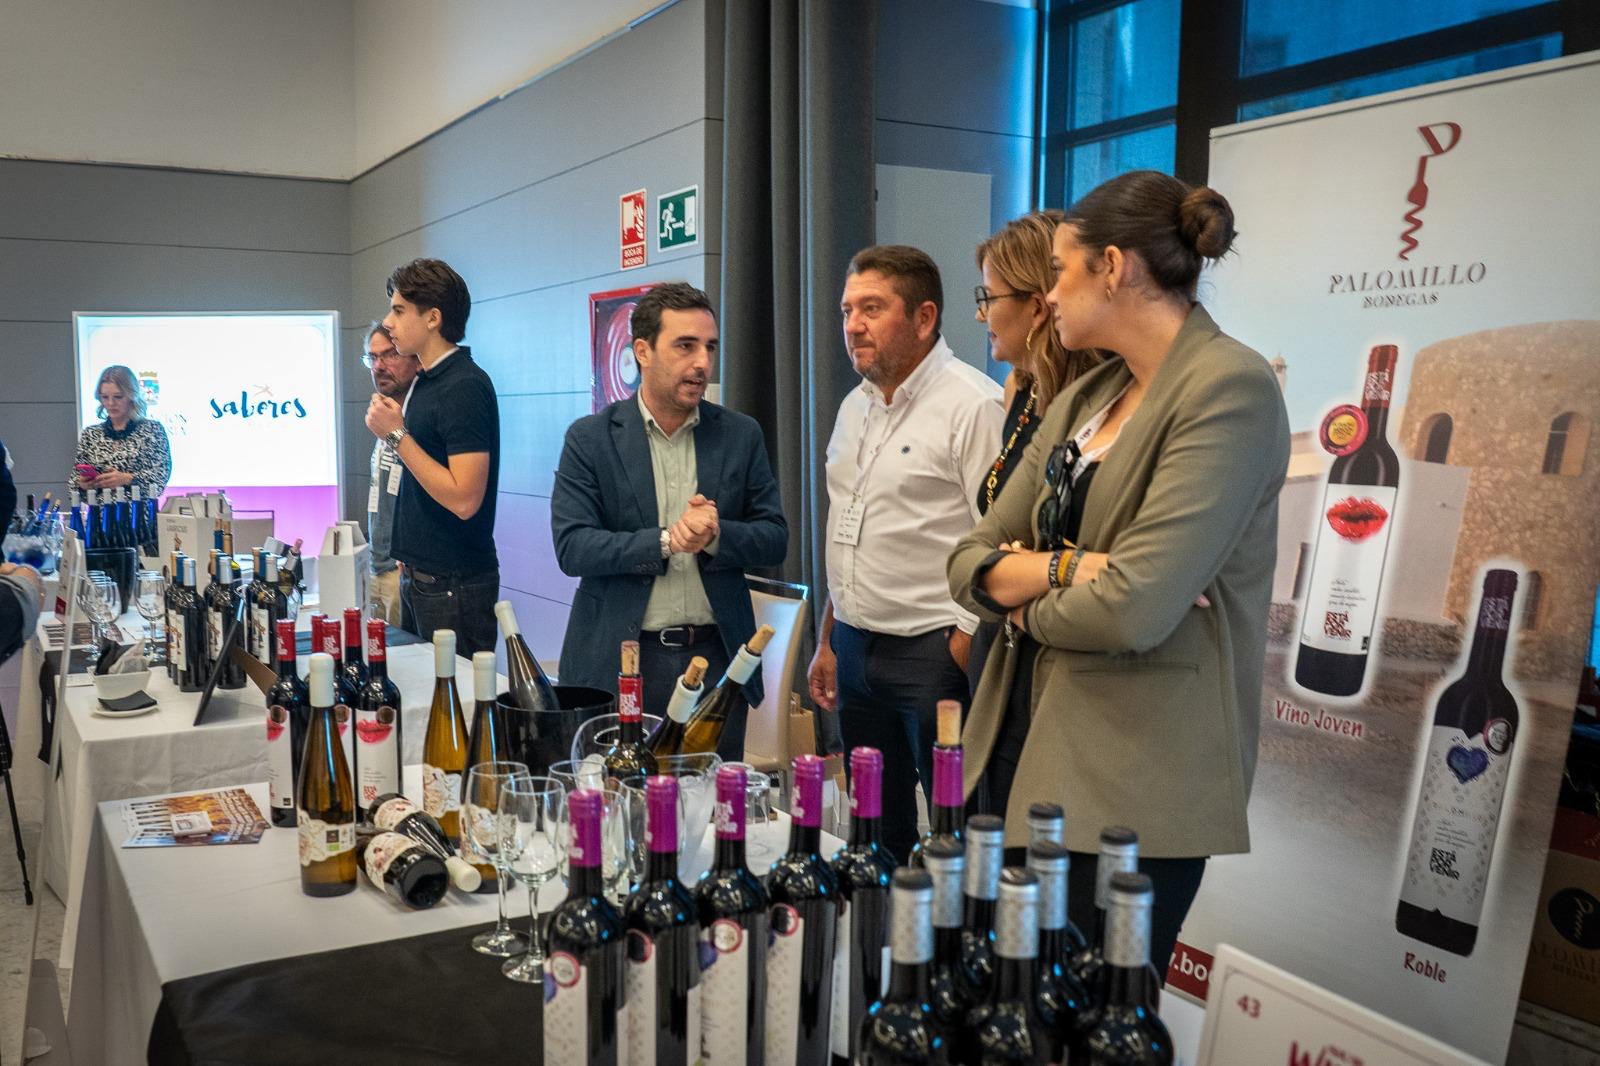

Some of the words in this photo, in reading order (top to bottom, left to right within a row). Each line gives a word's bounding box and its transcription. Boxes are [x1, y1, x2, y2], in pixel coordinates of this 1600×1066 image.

[1328, 262, 1487, 294] PALOMILLO
[1362, 291, 1441, 309] BODEGAS
[209, 390, 307, 419] saberes
[1275, 699, 1310, 726] Vino
[1314, 708, 1363, 737] Joven
[1168, 951, 1211, 982] .bo
[1403, 951, 1447, 984] Roble
[1237, 994, 1262, 1019] 43
